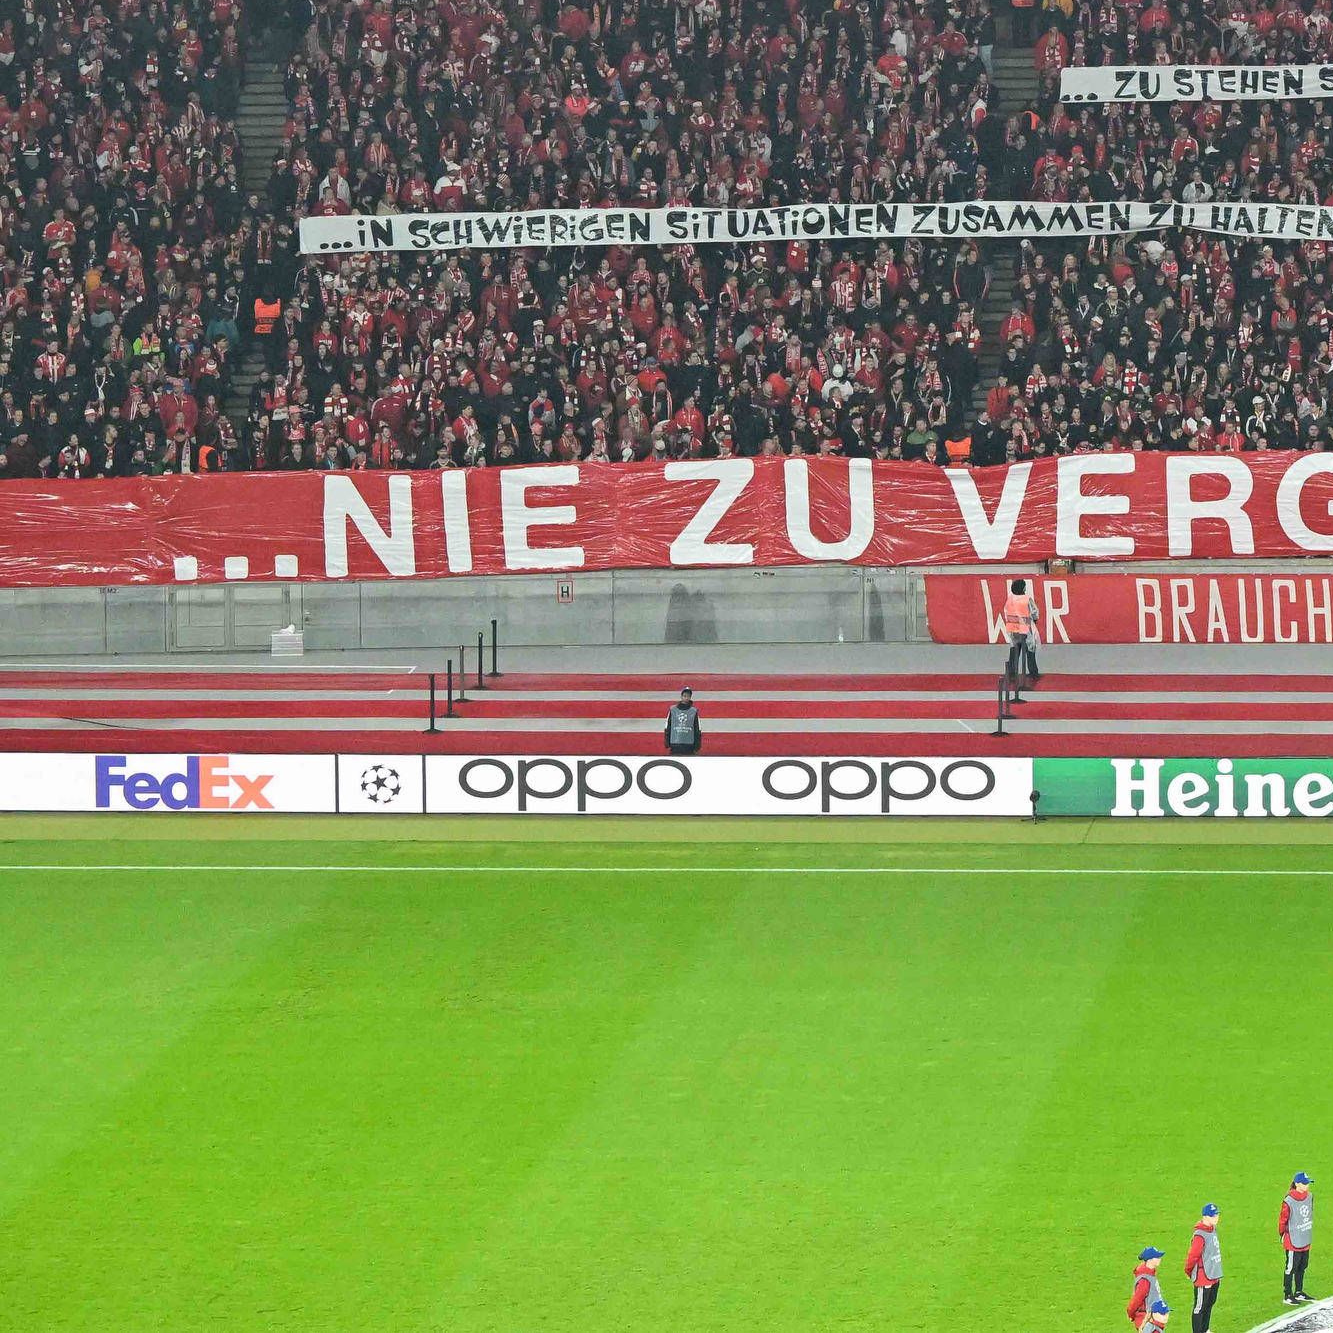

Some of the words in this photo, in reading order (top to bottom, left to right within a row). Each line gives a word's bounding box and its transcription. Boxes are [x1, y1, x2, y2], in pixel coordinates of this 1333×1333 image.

[1115, 70, 1161, 99] ZU
[1173, 69, 1303, 99] STEHEN
[911, 204, 1131, 235] ZUSAMMEN
[1147, 204, 1195, 227] ZU
[665, 458, 876, 565] ZU
[561, 586, 569, 597] H
[95, 755, 275, 809] FedEx
[459, 758, 692, 812] oppo
[762, 759, 996, 813] oppo
